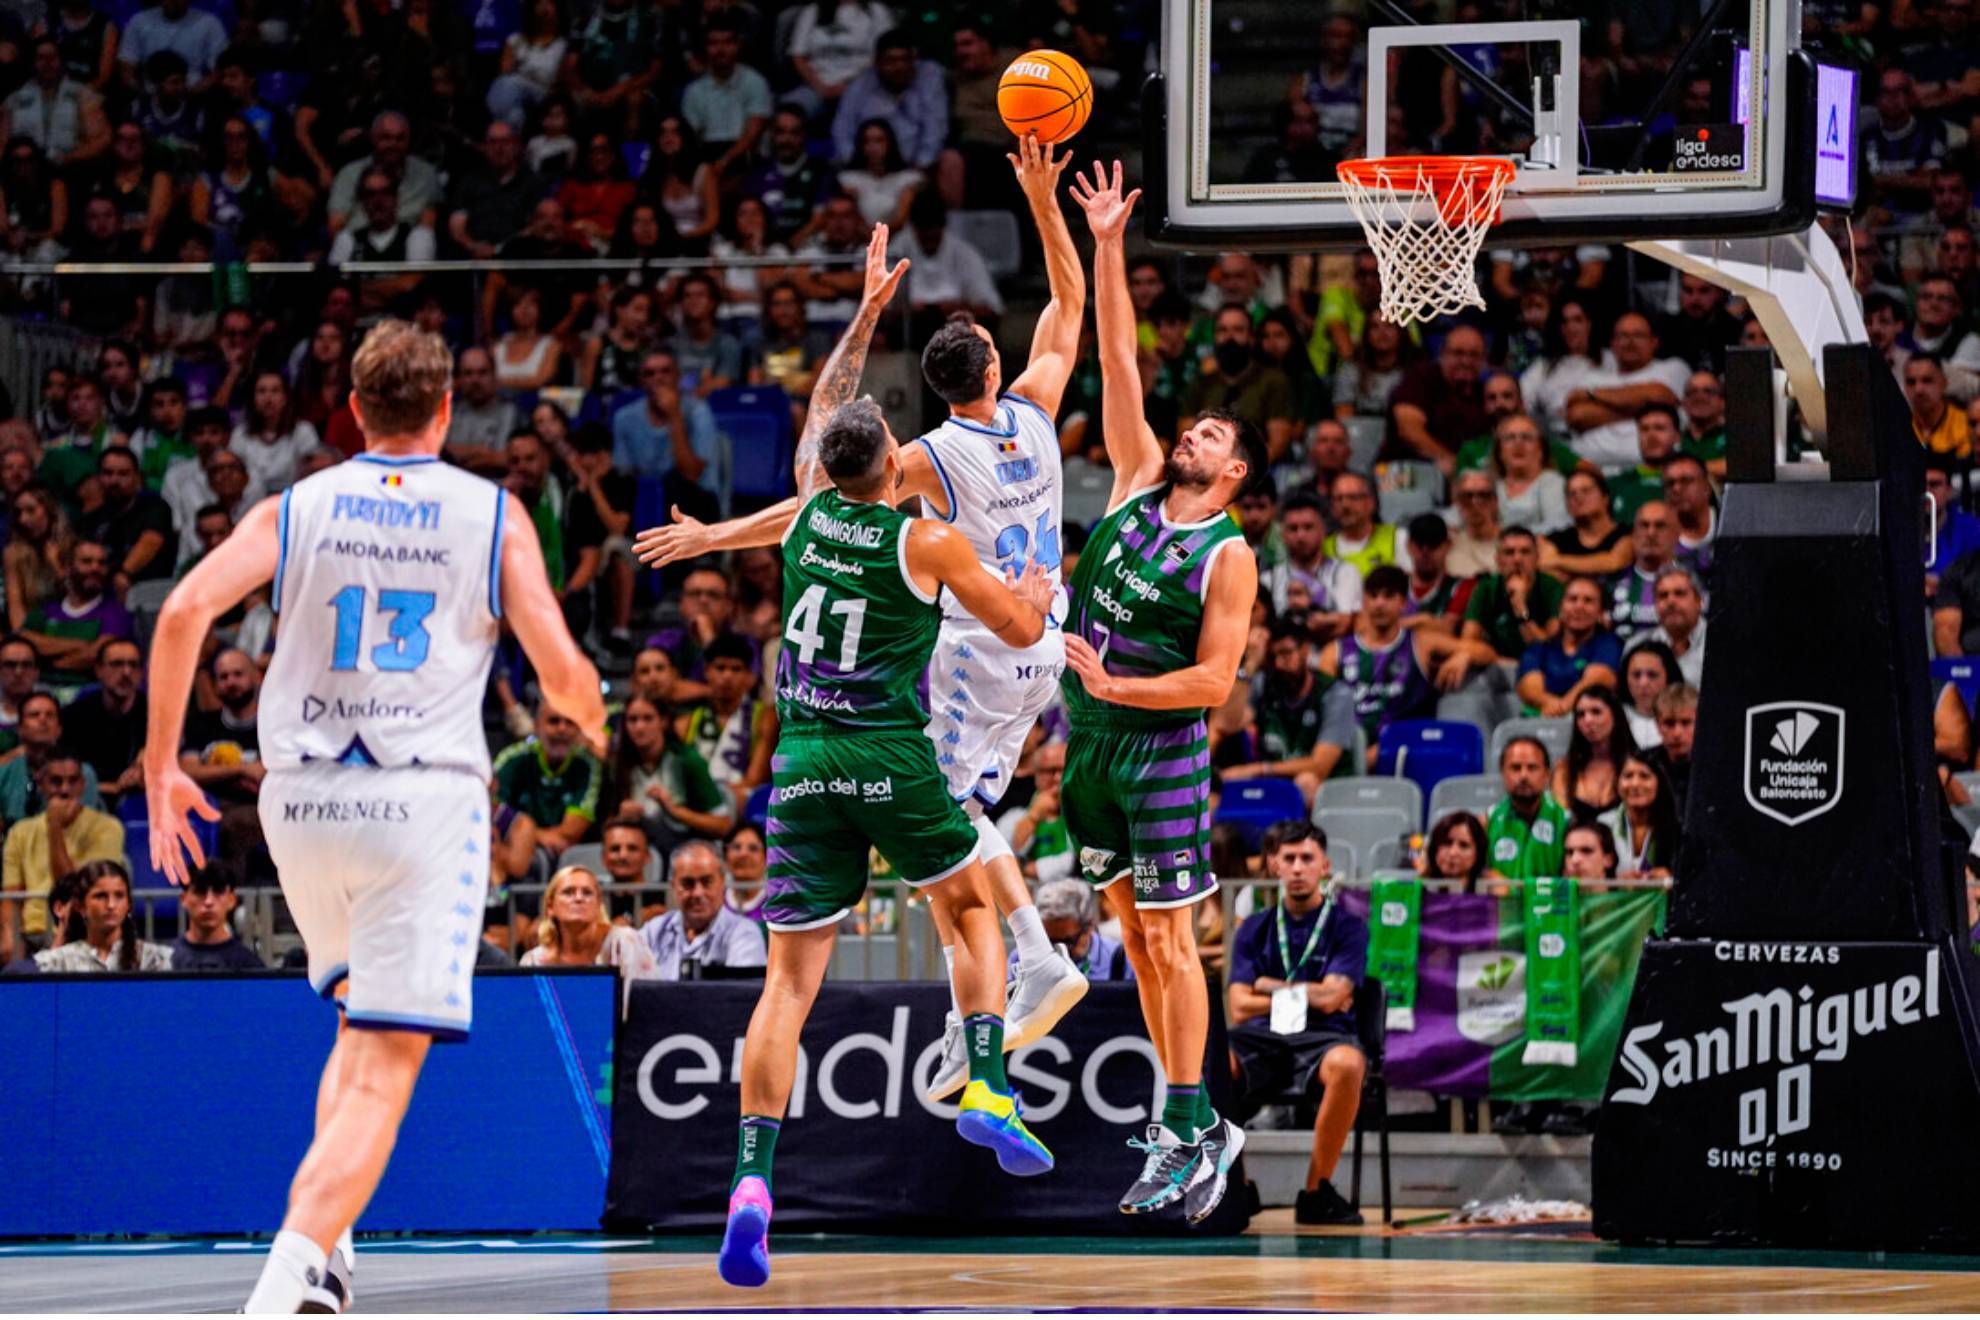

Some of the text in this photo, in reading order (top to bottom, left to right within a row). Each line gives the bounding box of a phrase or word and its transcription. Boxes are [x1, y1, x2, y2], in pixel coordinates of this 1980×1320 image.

[1675, 138, 1706, 155] liga
[1675, 153, 1742, 169] endesa
[335, 540, 451, 566] MORABANC
[327, 585, 437, 672] 13
[785, 583, 867, 672] 41
[329, 697, 423, 719] Andorr
[1760, 758, 1828, 774] Fundación
[780, 776, 892, 801] costa del sol
[1769, 773, 1819, 790] Unicaja
[1760, 786, 1828, 800] Baloncesto
[1714, 941, 1841, 964] CERVEZAS
[1707, 1148, 1842, 1171] SINCE 1890
